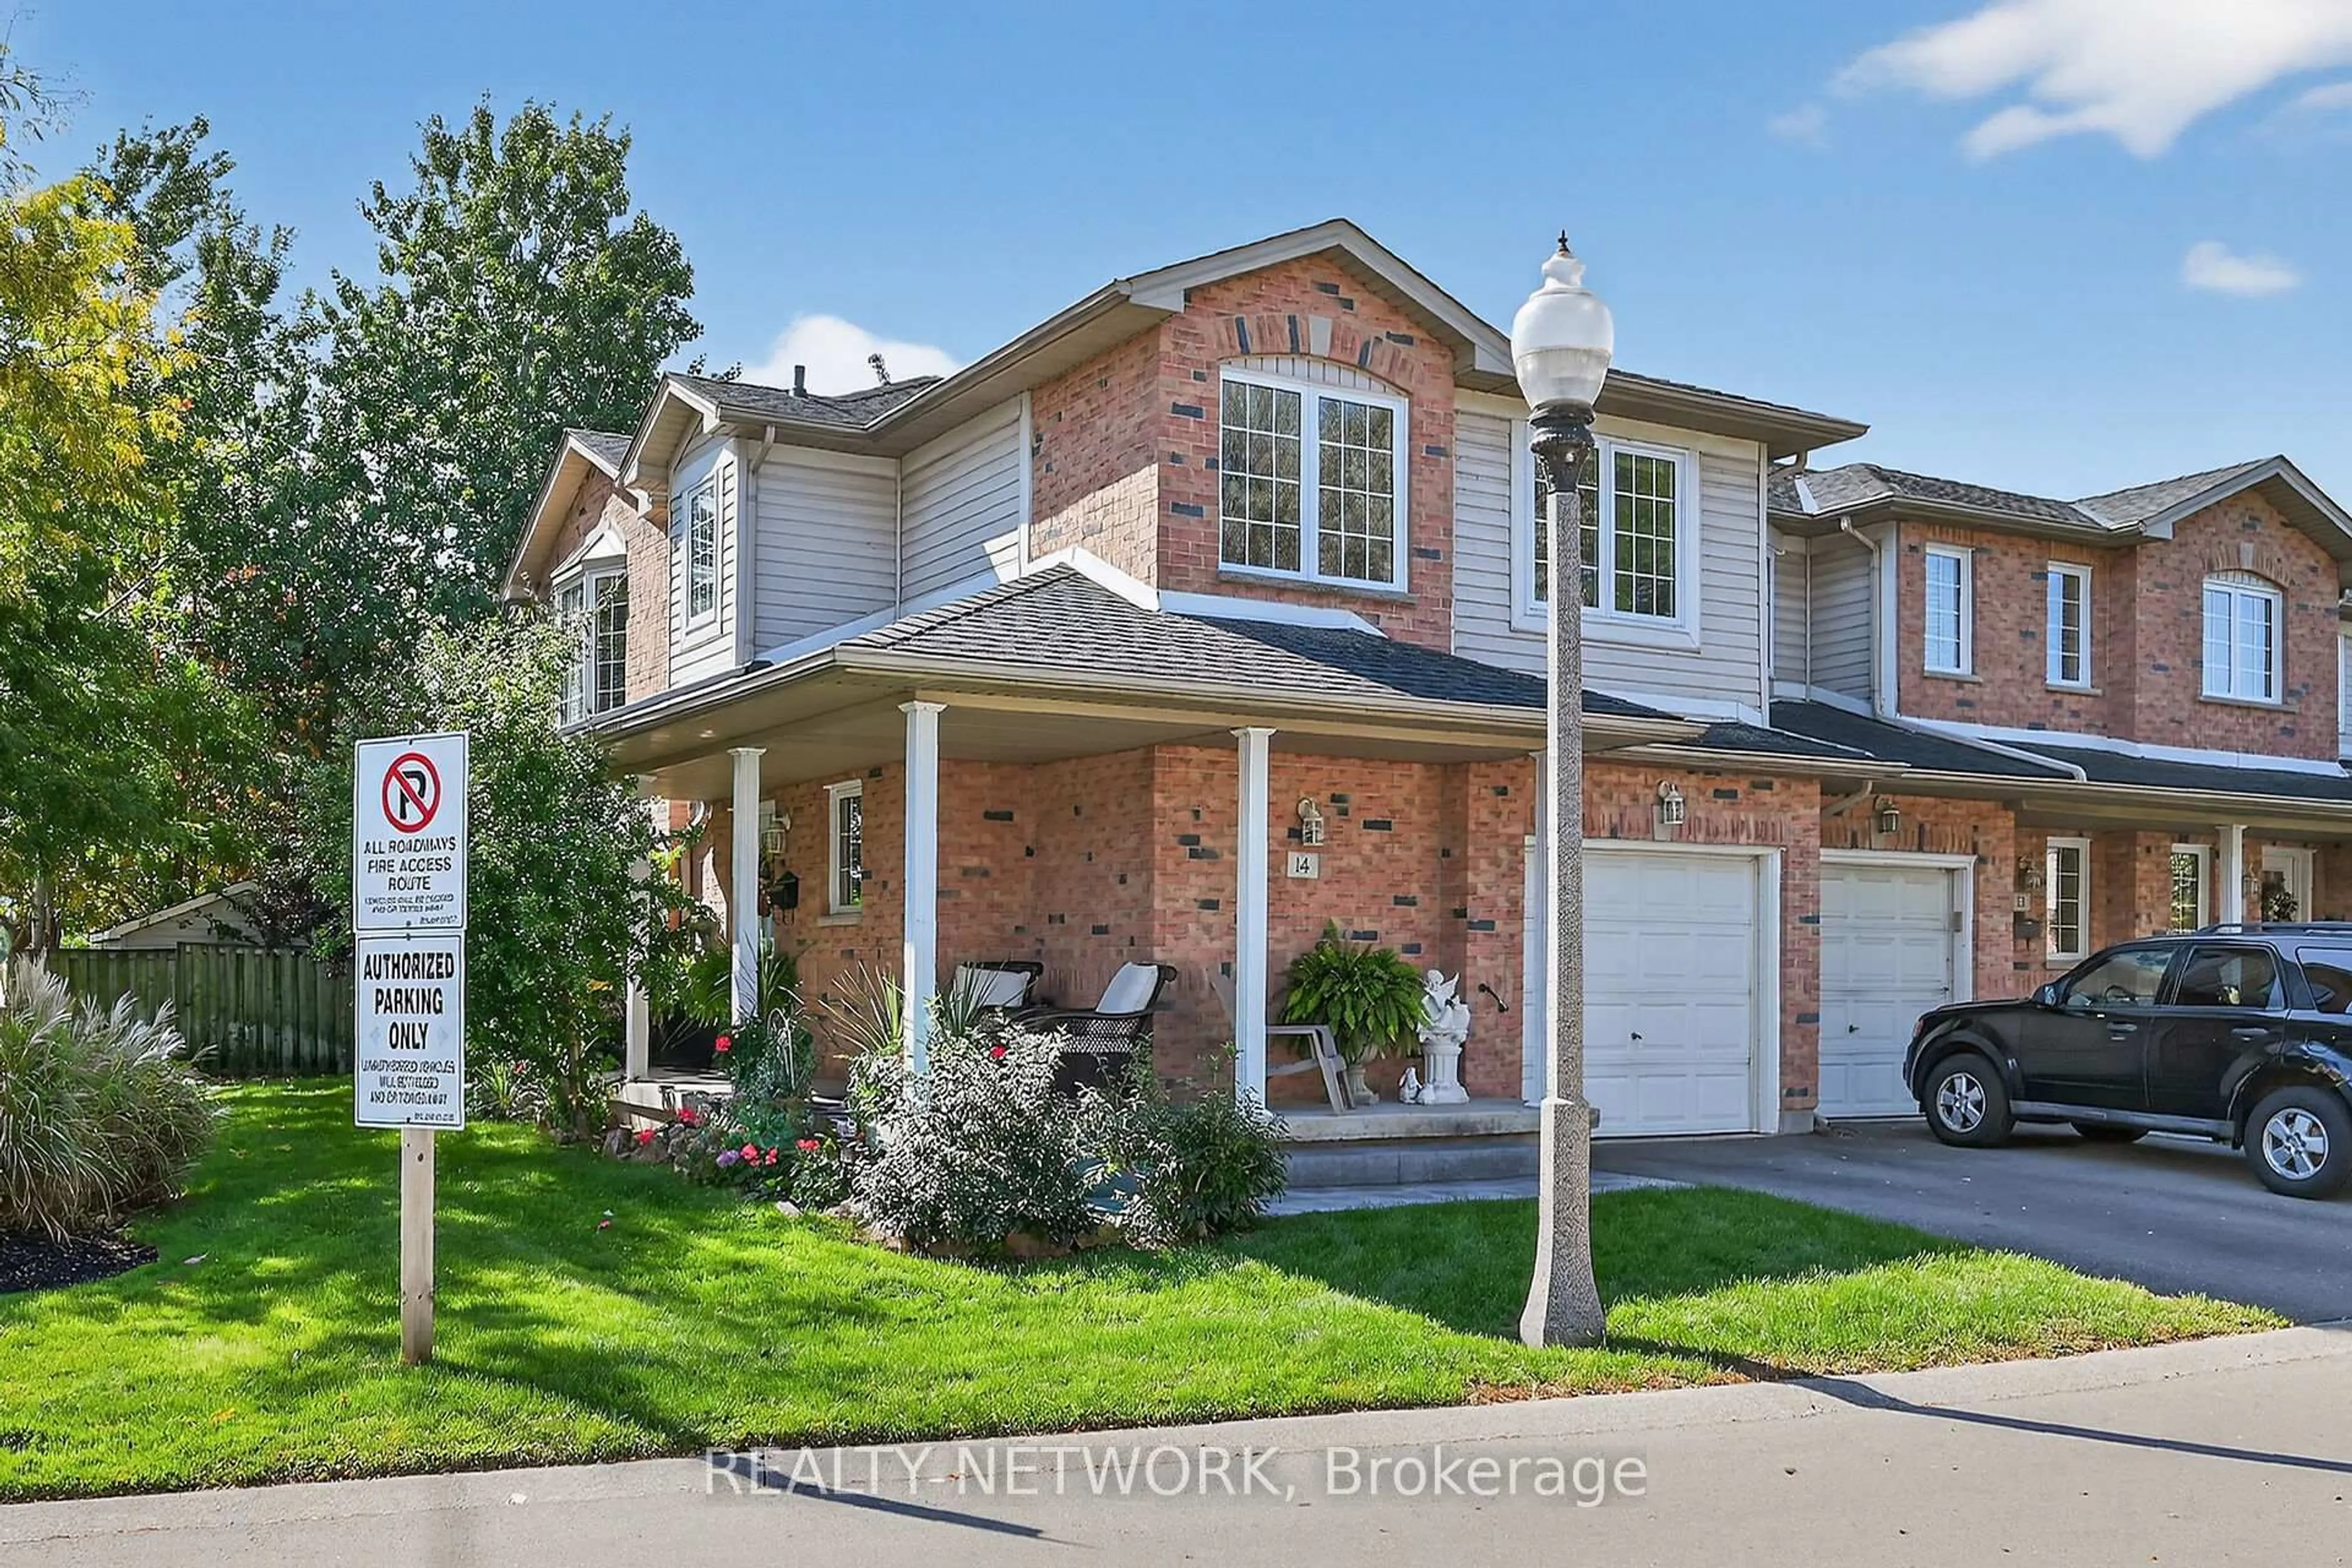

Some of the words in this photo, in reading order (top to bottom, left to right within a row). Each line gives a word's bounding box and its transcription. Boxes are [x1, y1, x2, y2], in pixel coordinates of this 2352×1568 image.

[364, 841, 385, 854] ALL
[388, 837, 456, 854] ROADWAYS
[368, 859, 395, 873] FIRE
[399, 856, 452, 872] ACCESS
[1295, 856, 1310, 873] 14
[388, 876, 431, 891] ROUTE
[363, 952, 454, 981] AUTHORIZED
[375, 987, 443, 1015] PARKING
[389, 1022, 429, 1050] ONLY
